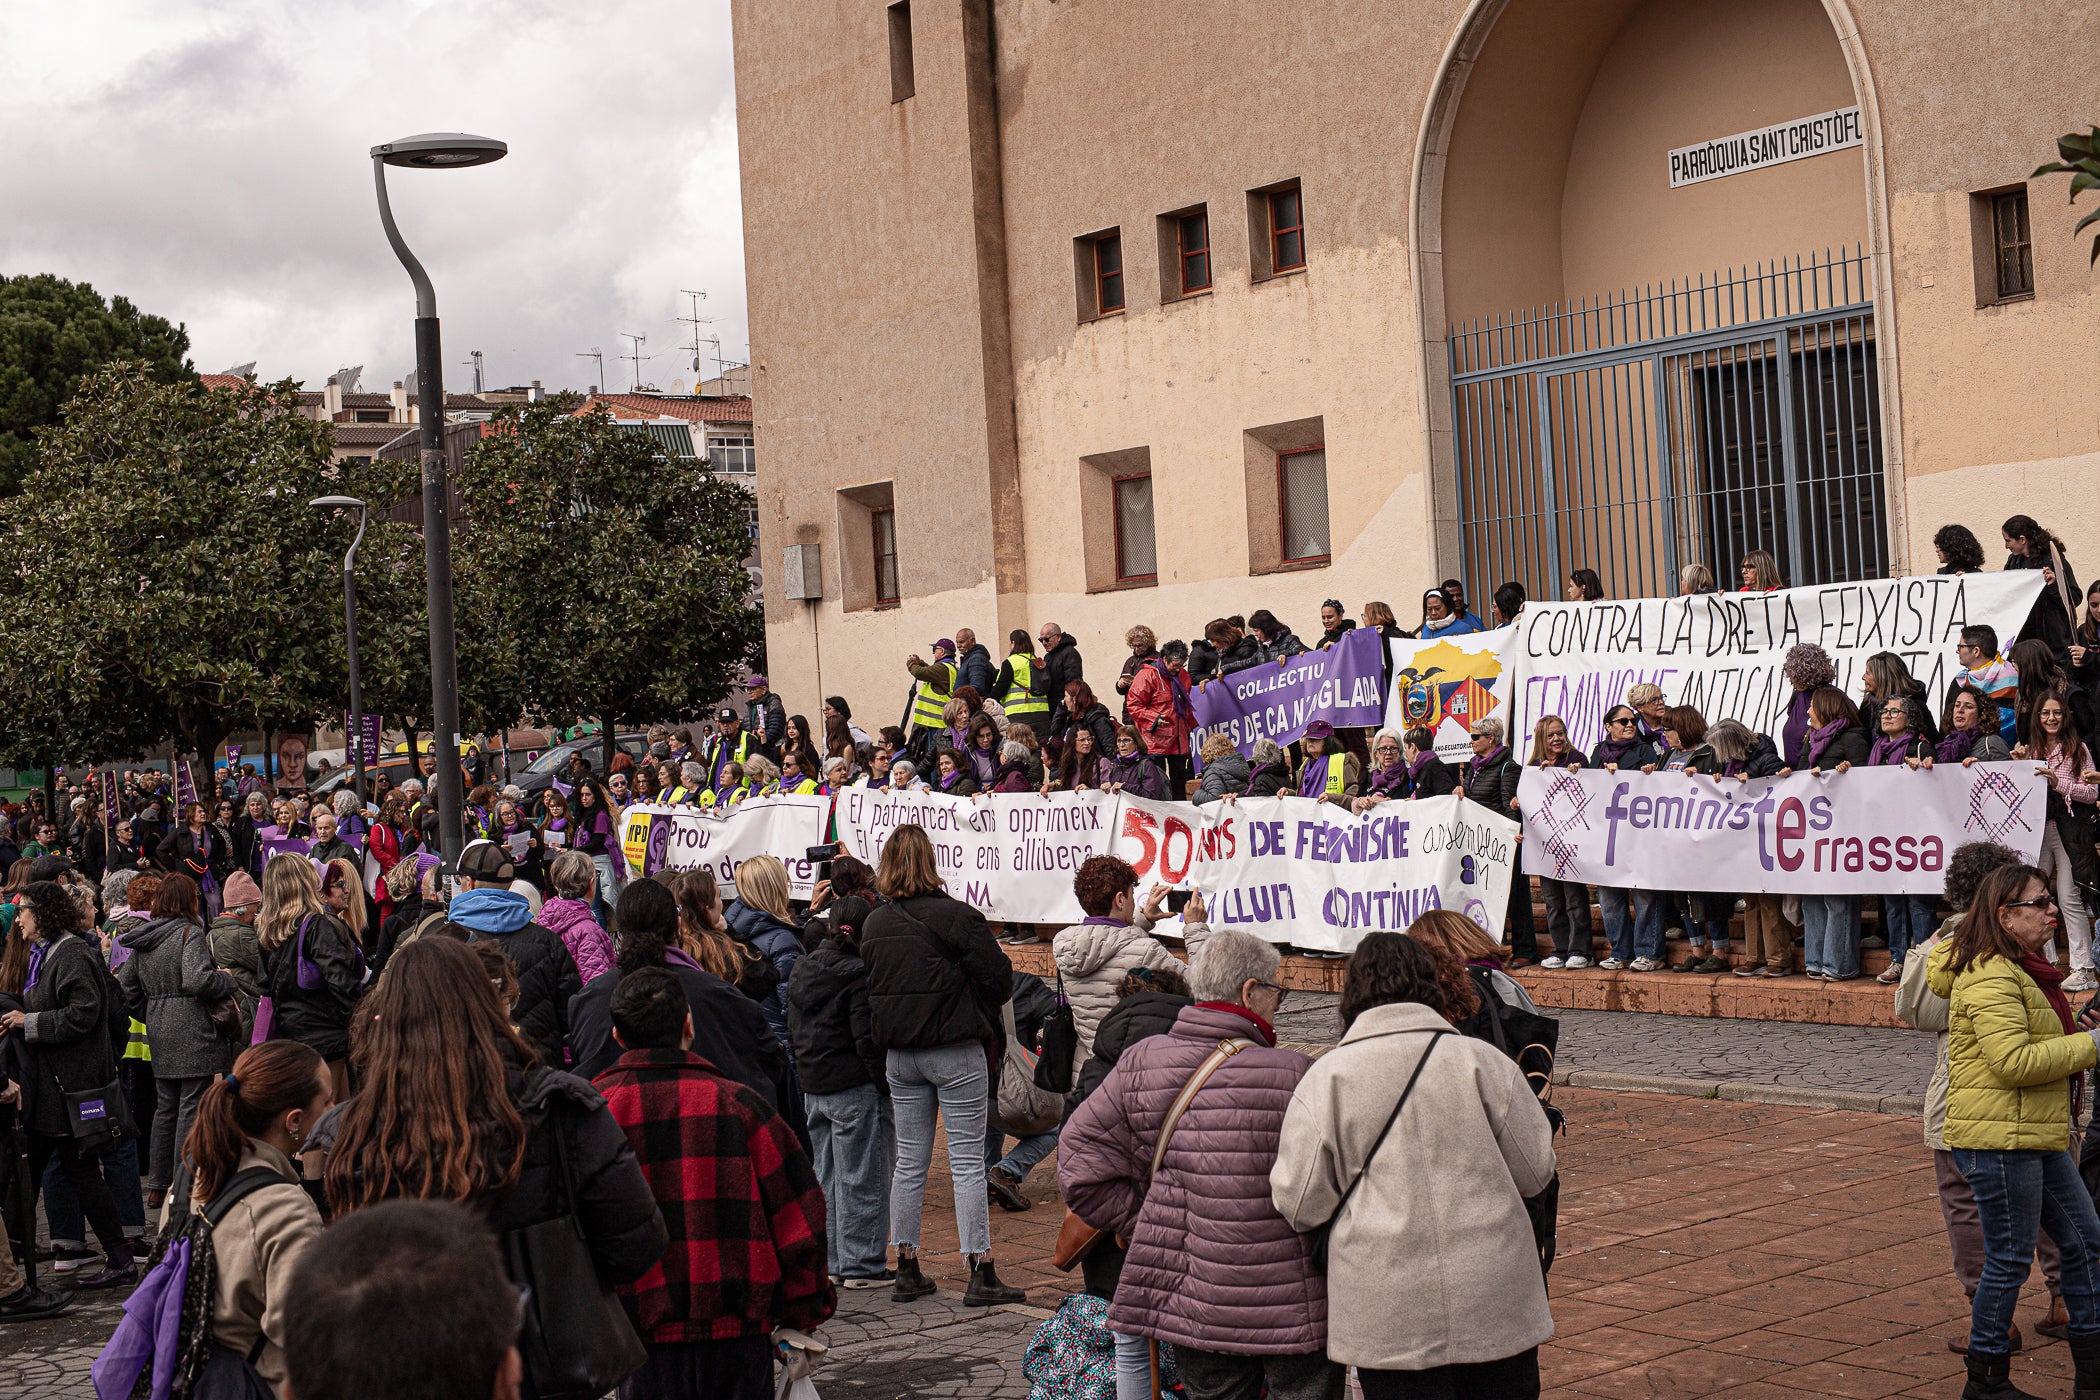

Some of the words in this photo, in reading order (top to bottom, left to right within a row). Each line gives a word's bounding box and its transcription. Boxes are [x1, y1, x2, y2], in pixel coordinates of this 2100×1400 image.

[1671, 138, 1749, 183] PARRÒQUIA
[1749, 129, 1787, 164] SANT
[1527, 602, 1643, 658] CONTRA
[1657, 594, 1692, 656] LA
[1706, 594, 1799, 658] DRETA
[1819, 578, 1968, 650] FEIXISTA
[1237, 662, 1325, 701] COL.LECTIU
[1244, 711, 1265, 744] DE
[1265, 703, 1289, 737] CA
[850, 793, 864, 825] El
[869, 796, 961, 835] patriarcat
[969, 808, 997, 834] ens
[668, 820, 710, 849] Prou
[856, 829, 870, 860] El
[1249, 821, 1286, 858] DE
[976, 846, 1001, 871] ens
